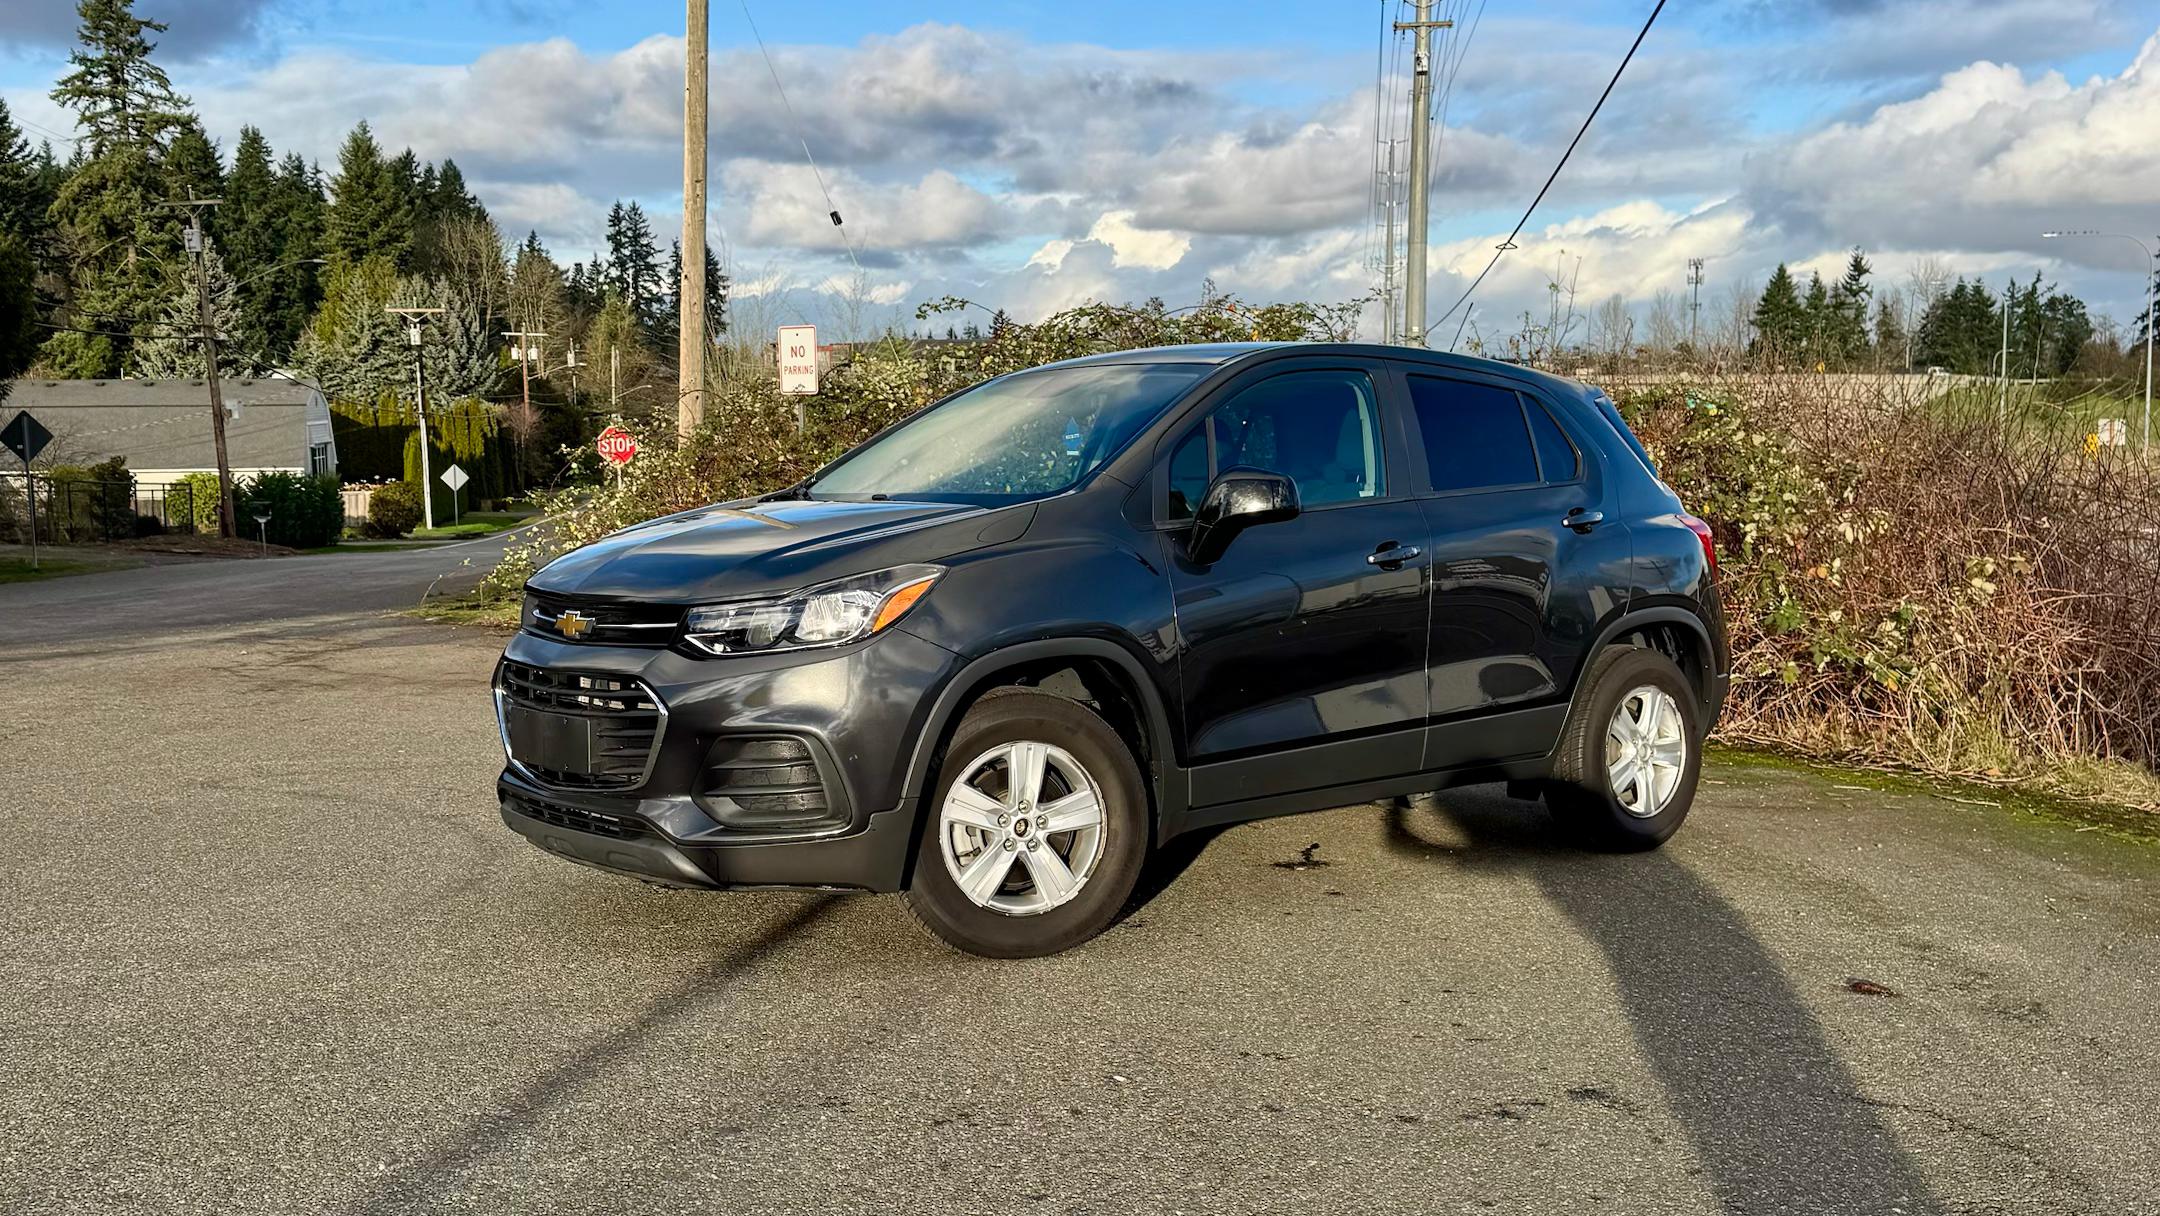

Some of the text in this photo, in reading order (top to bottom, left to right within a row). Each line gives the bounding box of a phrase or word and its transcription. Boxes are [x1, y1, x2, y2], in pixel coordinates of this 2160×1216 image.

[790, 345, 806, 358] NO
[783, 365, 814, 375] PARKING
[601, 437, 635, 452] STOP
